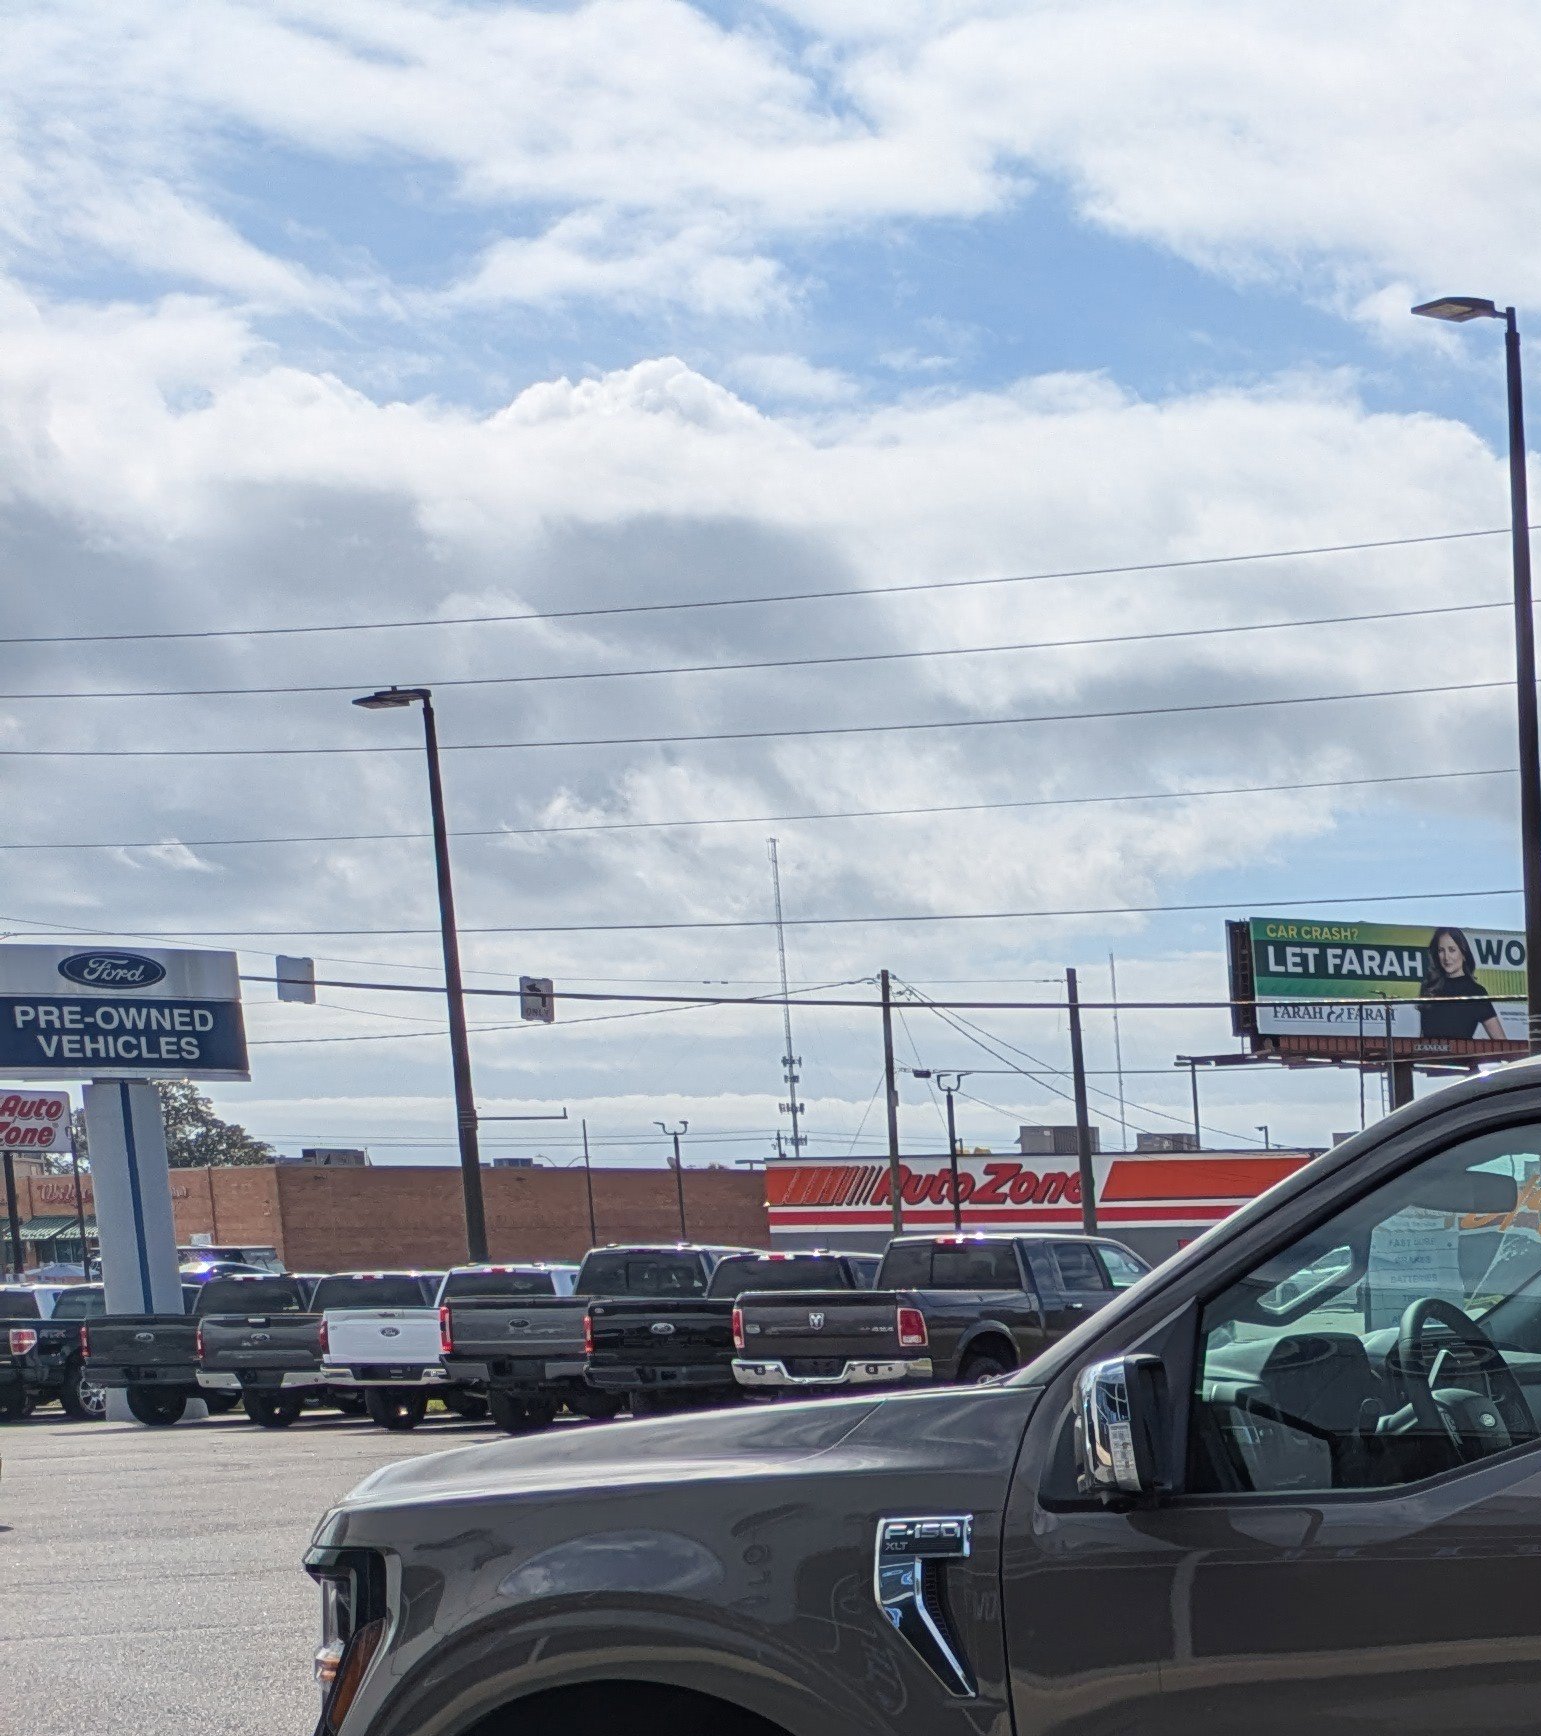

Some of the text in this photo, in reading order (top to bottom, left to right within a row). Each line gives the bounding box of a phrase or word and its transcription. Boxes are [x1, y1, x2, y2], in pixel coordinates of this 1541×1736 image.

[1266, 924, 1359, 940] CAR CRASH?
[83, 957, 145, 982] Ford
[1267, 945, 1320, 974] LET
[1326, 948, 1424, 978] FARAH
[14, 1005, 214, 1032] PRE-OWNED
[526, 1007, 549, 1018] ONLY
[1273, 1006, 1324, 1020] FARAH
[37, 1034, 201, 1060] VEHICLES
[0, 1095, 63, 1121] Auto
[870, 1163, 1083, 1206] AutoZone
[885, 1522, 961, 1539] F-150
[885, 1541, 908, 1551] XLT
